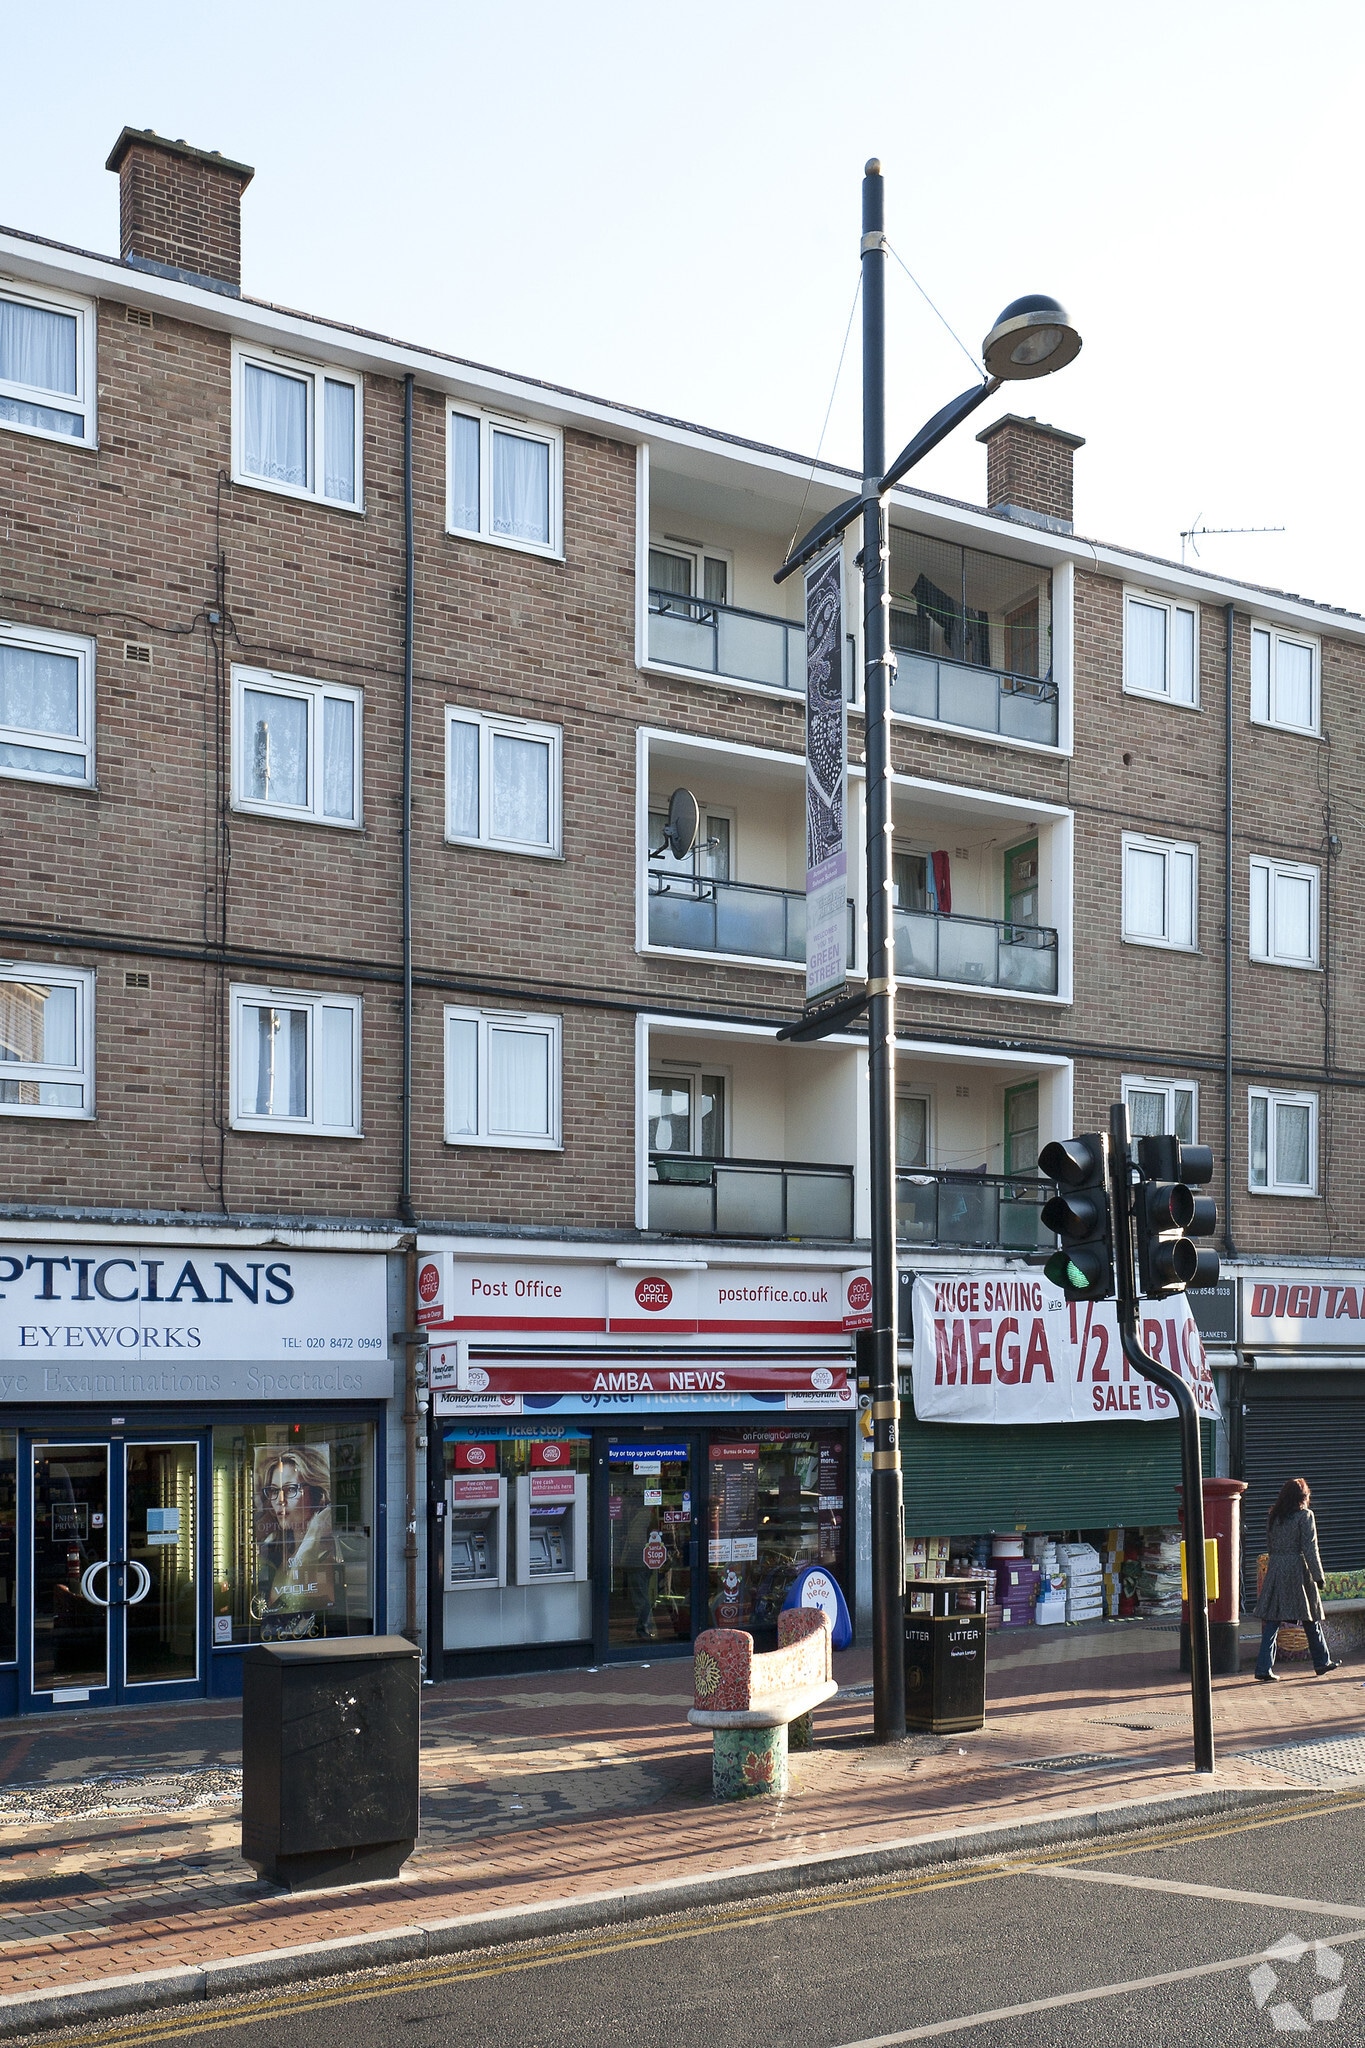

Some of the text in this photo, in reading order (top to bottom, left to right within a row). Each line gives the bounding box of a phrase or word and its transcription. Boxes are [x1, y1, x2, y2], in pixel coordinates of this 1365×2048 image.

[810, 942, 840, 969] GREEN
[809, 958, 842, 986] STREET
[423, 1271, 436, 1283] POST
[420, 1282, 438, 1295] OFFICE
[471, 1279, 562, 1298] Post Office
[643, 1284, 666, 1293] POST
[853, 1283, 868, 1293] POST
[1200, 1287, 1215, 1296] 8548
[1216, 1288, 1231, 1296] 1038
[638, 1294, 668, 1303] OFFICE
[718, 1286, 828, 1304] postoffice.co.uk
[850, 1292, 870, 1303] OFFICE
[935, 1282, 1042, 1312] HUGE SAVING
[1251, 1284, 1365, 1319] DIGITA
[18, 1326, 202, 1348] EYEWORKS
[282, 1337, 382, 1348] TEL: 020 8472 0949
[934, 1317, 1054, 1385] MEGA
[433, 1364, 454, 1374] MoneyGram
[42, 1367, 220, 1392] Examinations
[247, 1365, 363, 1398] Spectacles
[593, 1371, 726, 1391] AMBA NEWS
[441, 1394, 497, 1404] MoneyGram
[791, 1391, 837, 1400] MoneyGram
[1093, 1381, 1215, 1412] SALE IS ACK
[467, 1425, 565, 1438] oyster Ticket Stop
[752, 1431, 779, 1441] Foreign
[779, 1430, 811, 1441] Currency
[55, 1522, 85, 1530] PRIVATE
[647, 1550, 663, 1559] Stop
[274, 1582, 318, 1595] VOGUE
[808, 1577, 827, 1589] play
[806, 1589, 830, 1600] here!
[261, 1625, 327, 1641] GUCCI
[905, 1630, 929, 1641] LITTER
[949, 1630, 979, 1641] LITTER
